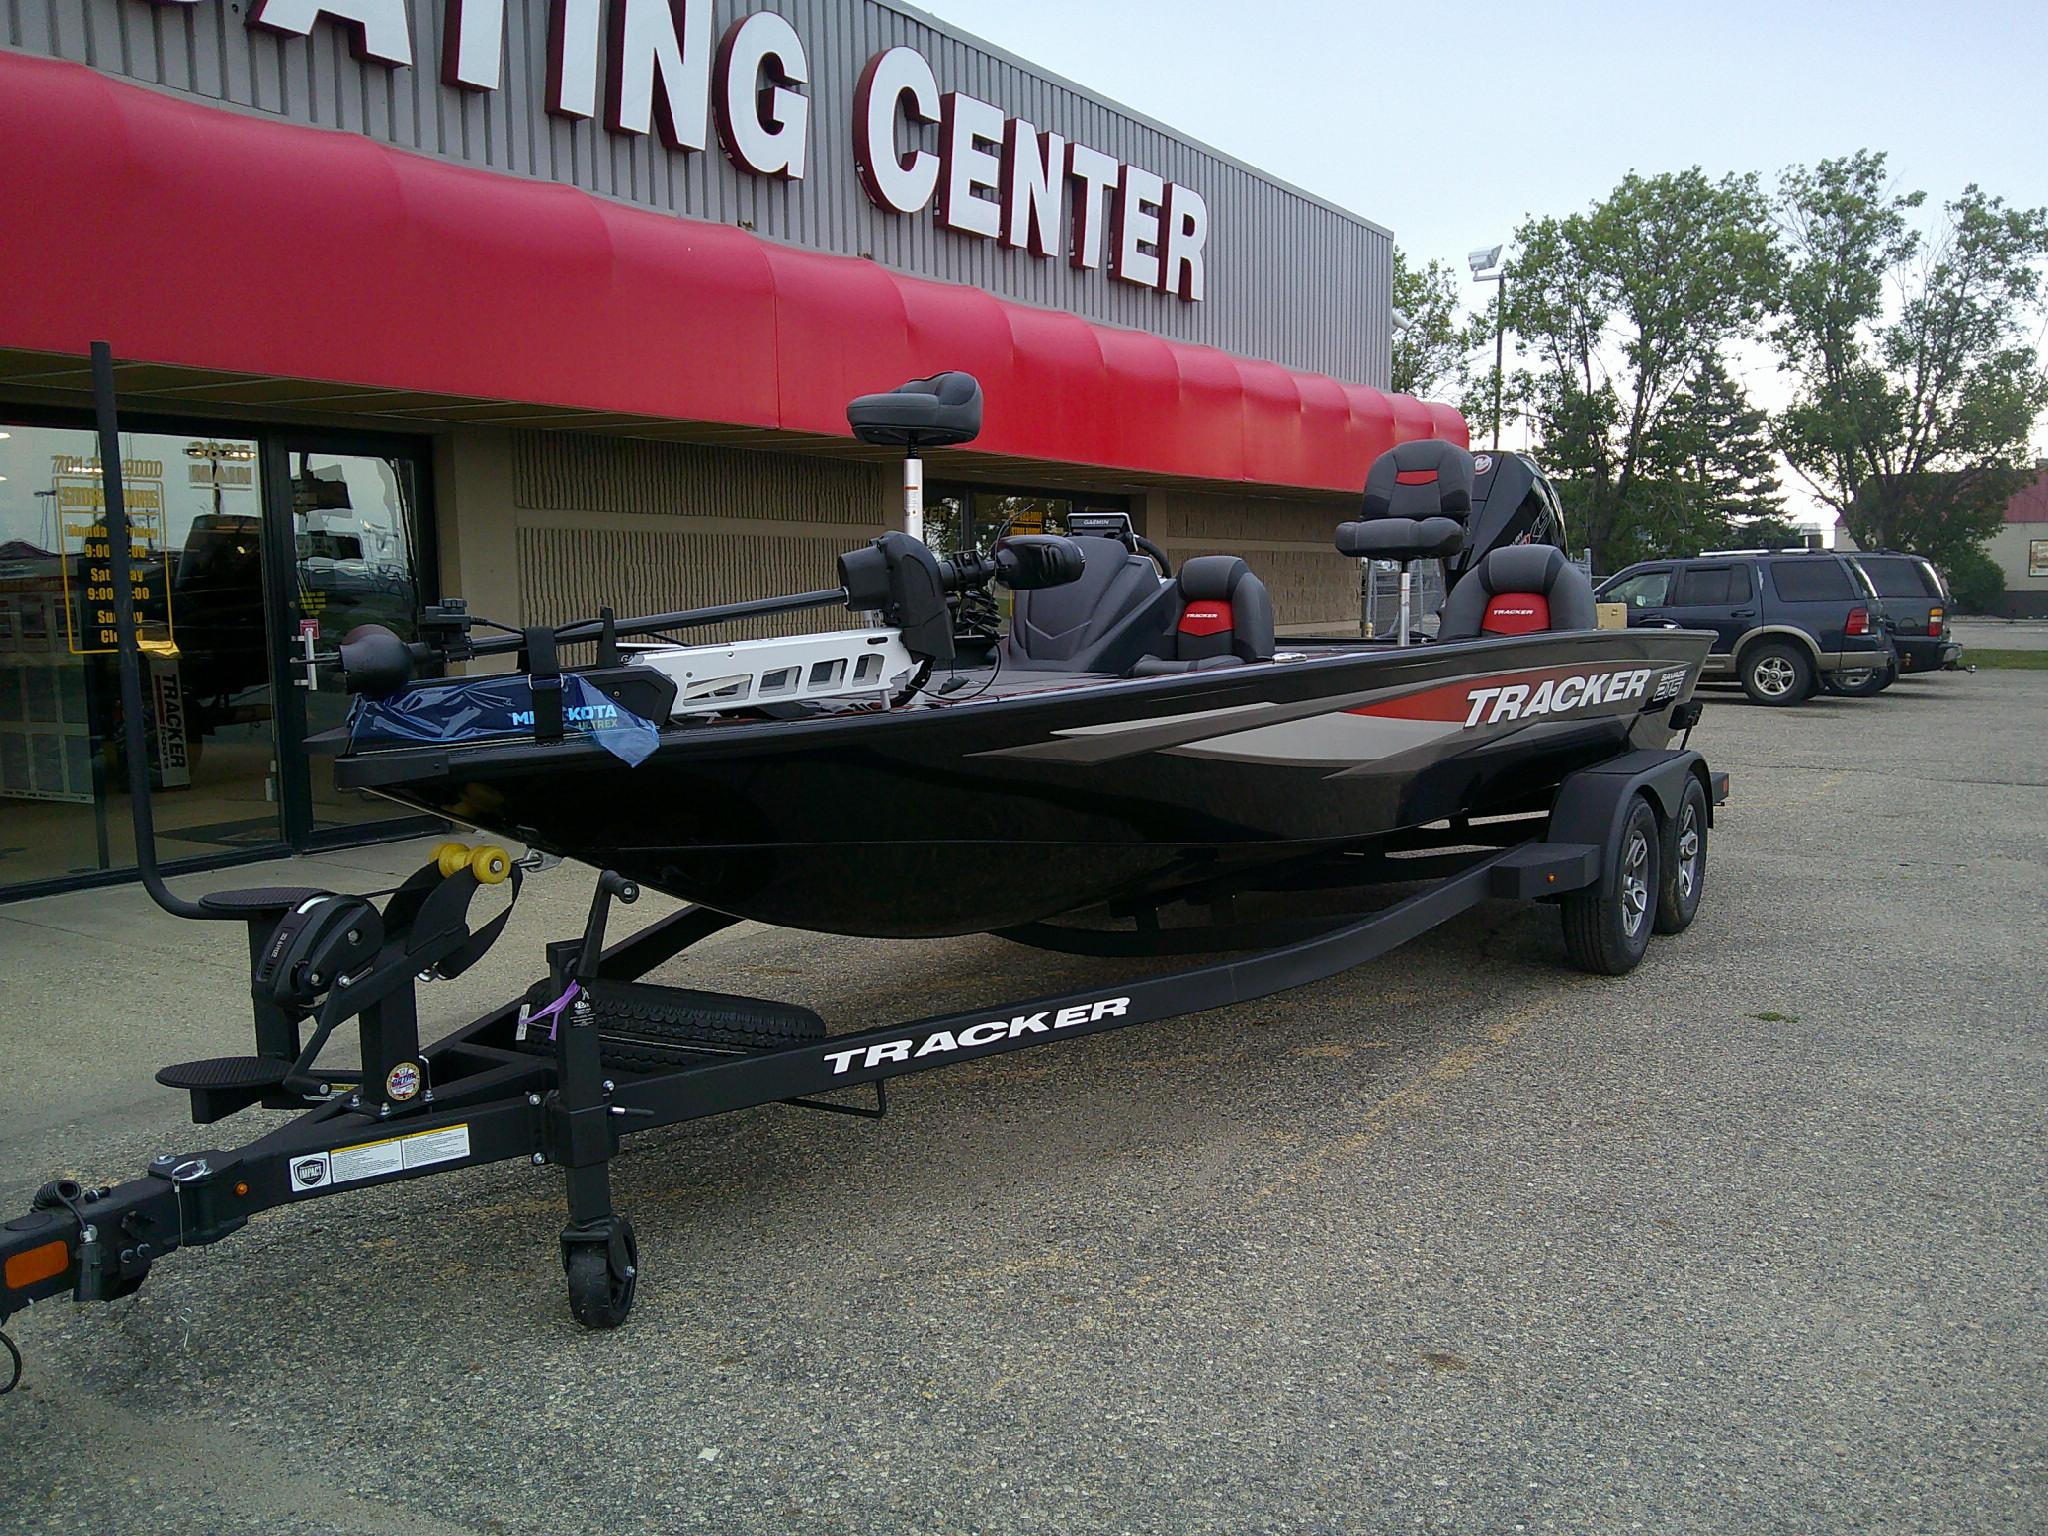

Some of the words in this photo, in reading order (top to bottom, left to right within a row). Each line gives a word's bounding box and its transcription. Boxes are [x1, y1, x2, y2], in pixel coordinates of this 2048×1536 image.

[165, 0, 810, 181] ING
[854, 45, 1208, 302] CENTER
[66, 523, 108, 538] Monda
[128, 544, 146, 559] :00
[90, 567, 144, 582] Satay
[87, 587, 115, 601] 9:00
[131, 587, 150, 600] :00
[97, 610, 143, 625] Suy
[1463, 669, 1651, 728] TRACKER
[162, 673, 186, 768] TRACKER
[568, 705, 618, 721] KOTA
[823, 997, 1131, 1075] TRACKER
[300, 1165, 323, 1180] IMPACT
